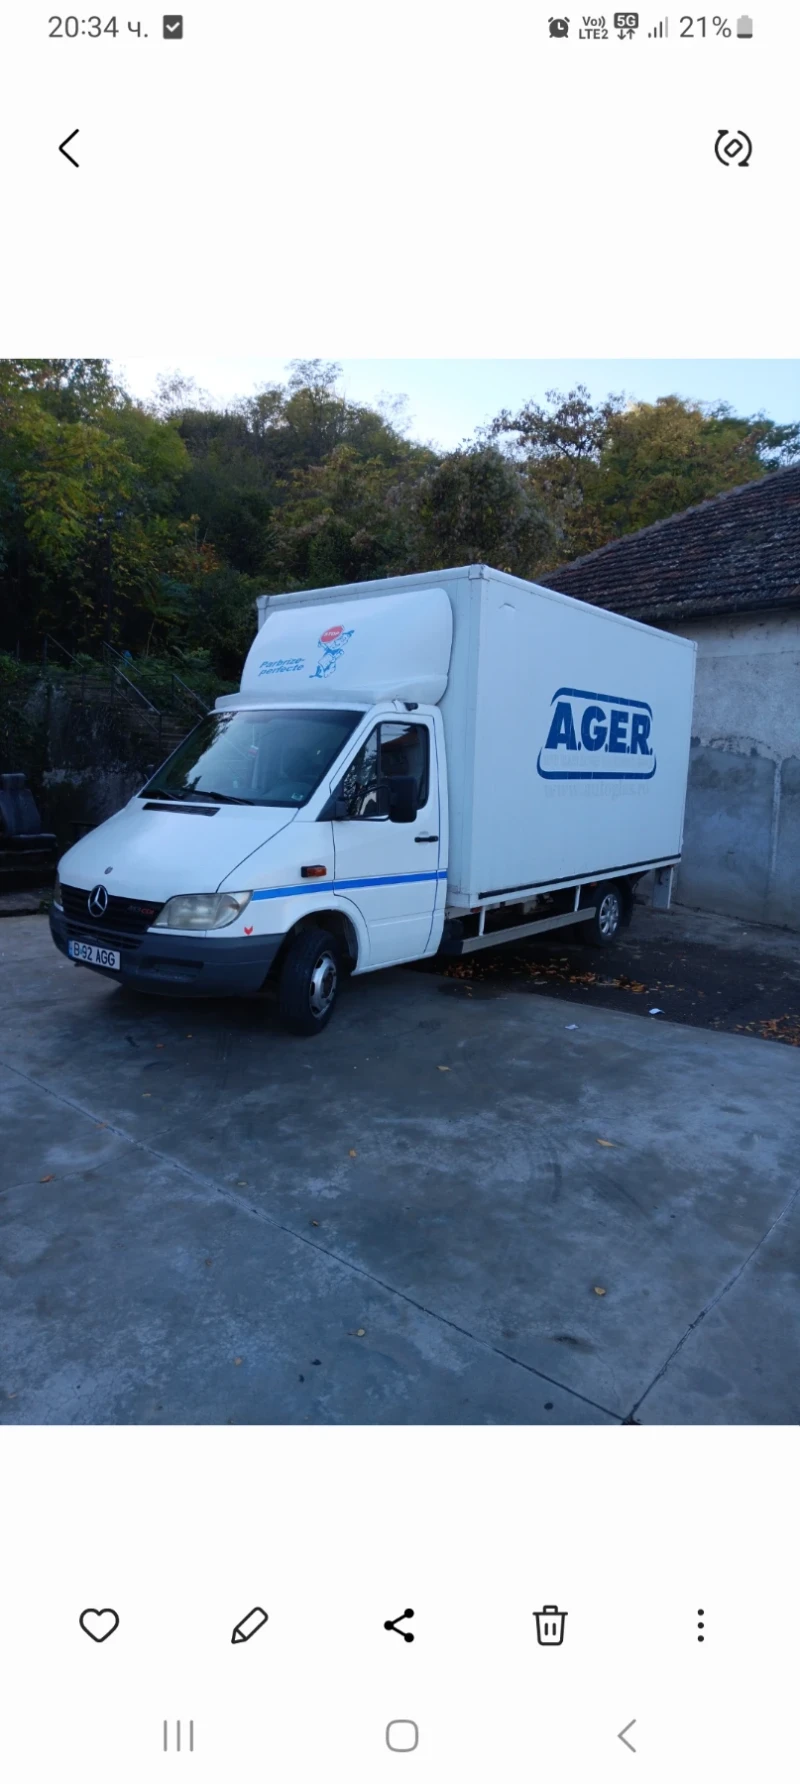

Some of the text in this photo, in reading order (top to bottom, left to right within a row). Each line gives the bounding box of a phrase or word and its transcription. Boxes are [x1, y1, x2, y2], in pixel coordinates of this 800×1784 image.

[258, 664, 304, 675] perfecte
[82, 944, 93, 961] 92
[96, 948, 115, 966] AGG
